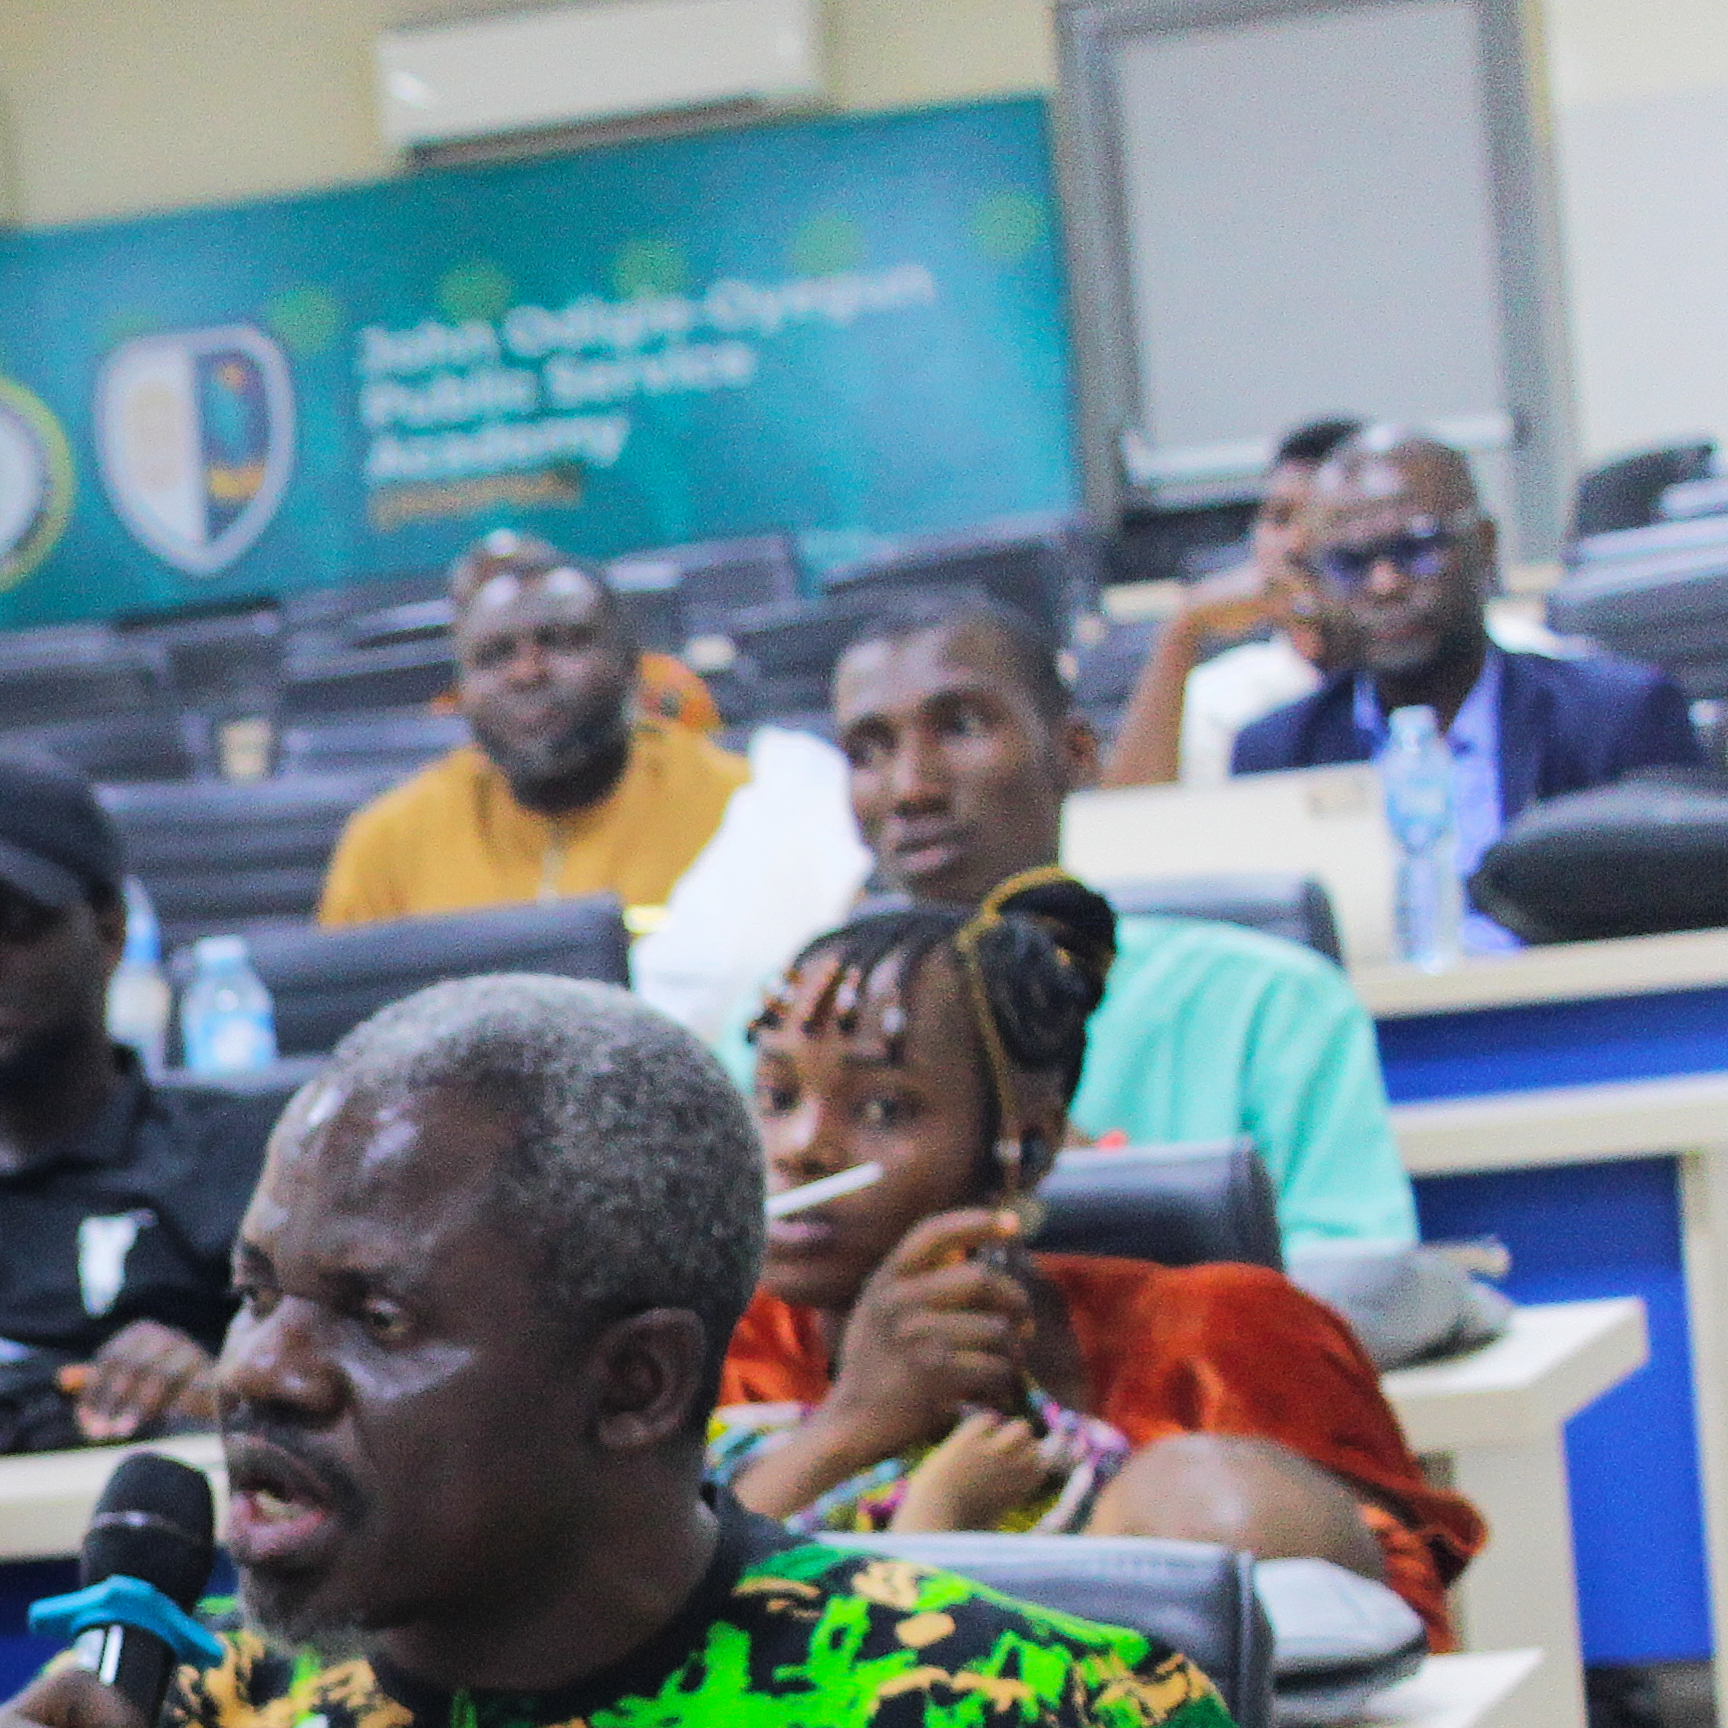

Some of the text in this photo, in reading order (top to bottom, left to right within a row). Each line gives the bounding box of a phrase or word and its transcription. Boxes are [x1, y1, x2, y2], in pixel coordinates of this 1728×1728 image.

[360, 341, 758, 430] Public Service
[365, 415, 628, 481] Academy
